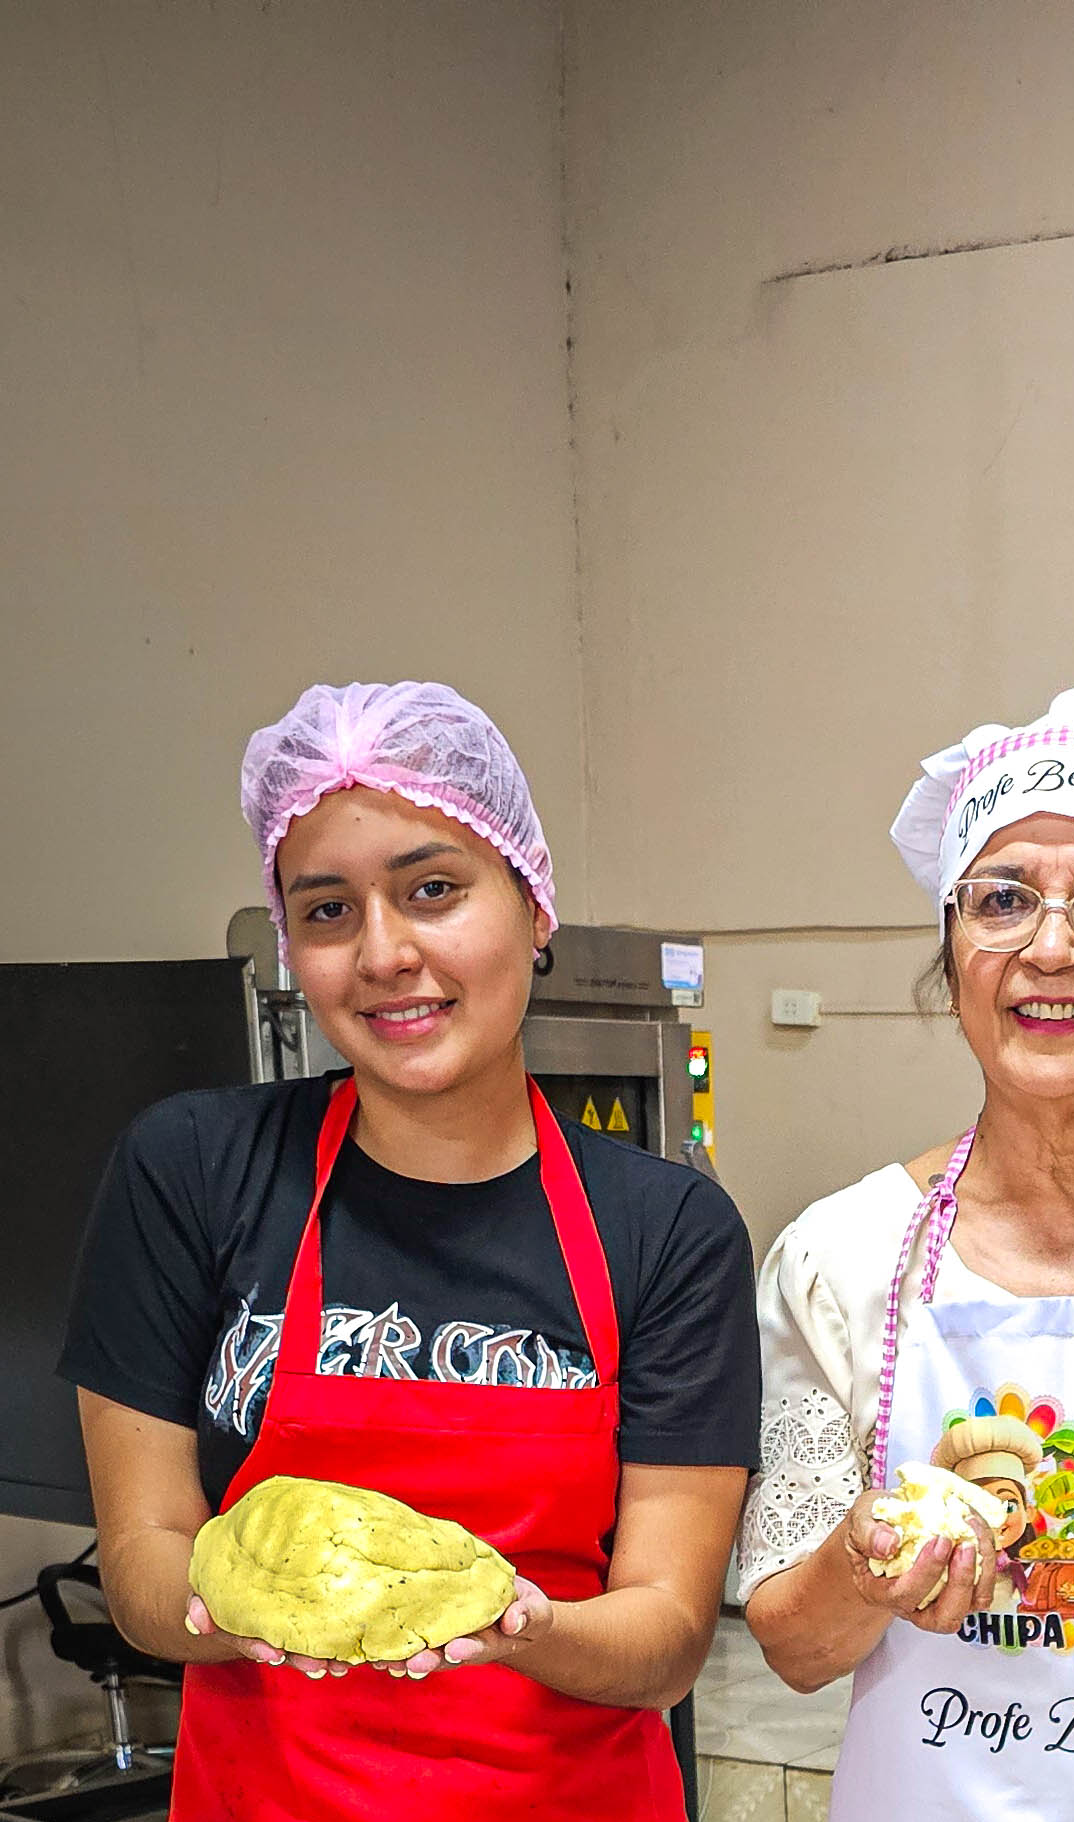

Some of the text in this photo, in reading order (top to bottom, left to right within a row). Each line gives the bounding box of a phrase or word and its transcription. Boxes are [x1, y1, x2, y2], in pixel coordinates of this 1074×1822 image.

[958, 773, 1014, 857] Profe
[957, 1612, 1065, 1649] CHIPA
[921, 1687, 1032, 1753] Profe
